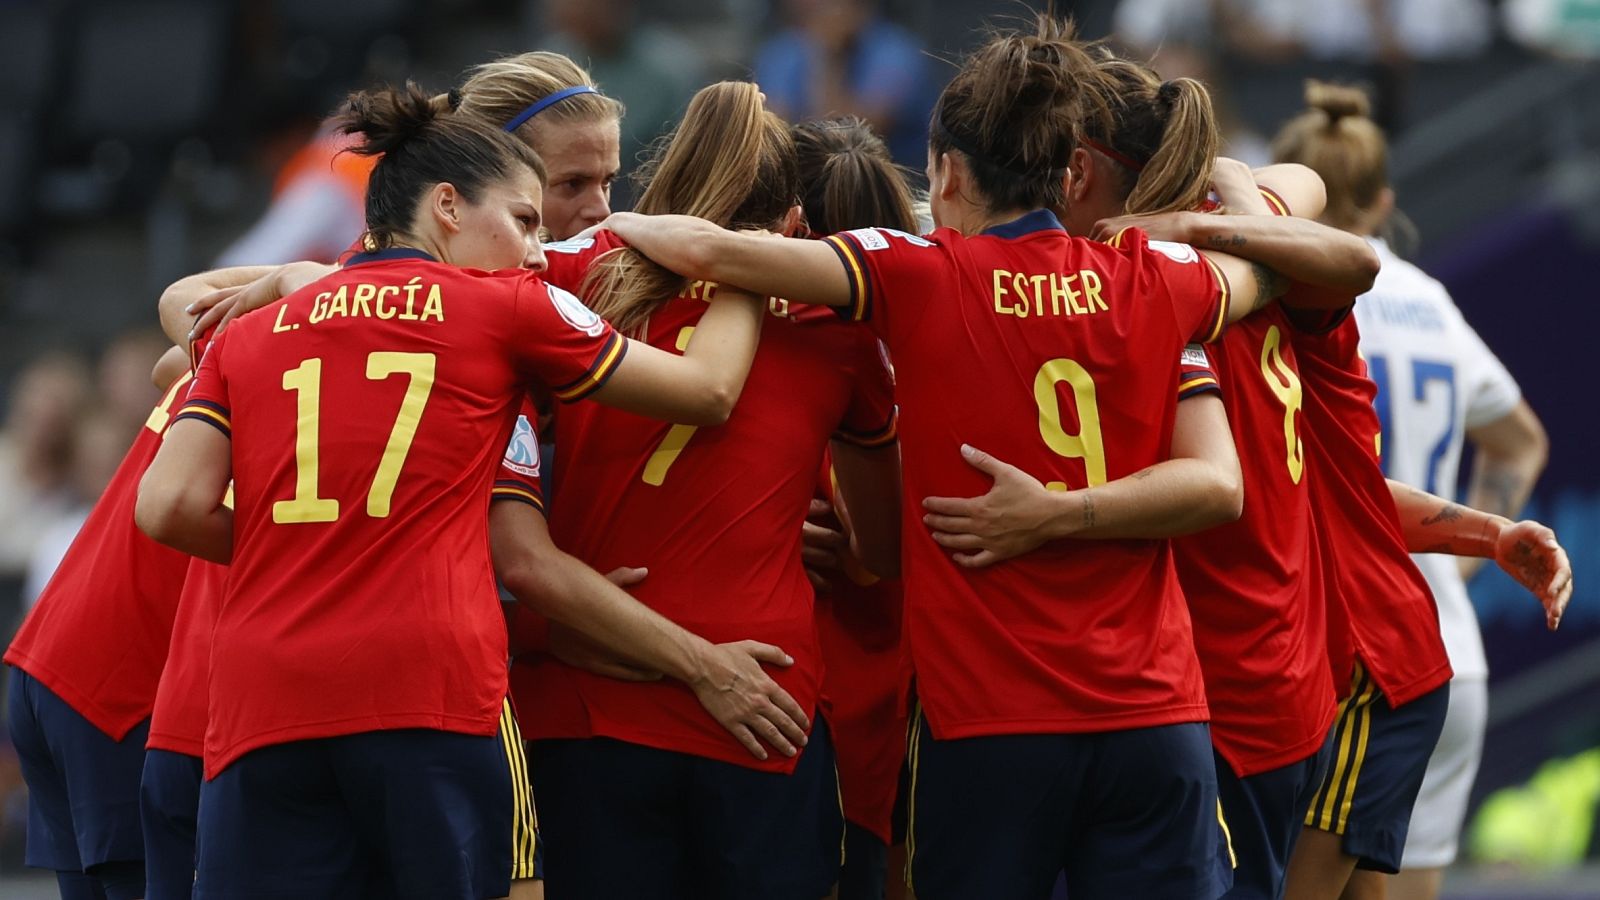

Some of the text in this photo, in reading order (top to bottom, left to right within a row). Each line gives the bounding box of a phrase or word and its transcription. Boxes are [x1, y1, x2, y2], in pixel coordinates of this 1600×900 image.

[272, 276, 445, 334] L. GARCÍA
[993, 269, 1109, 319] ESTHER
[272, 351, 436, 524] 17
[1034, 358, 1107, 492] 9
